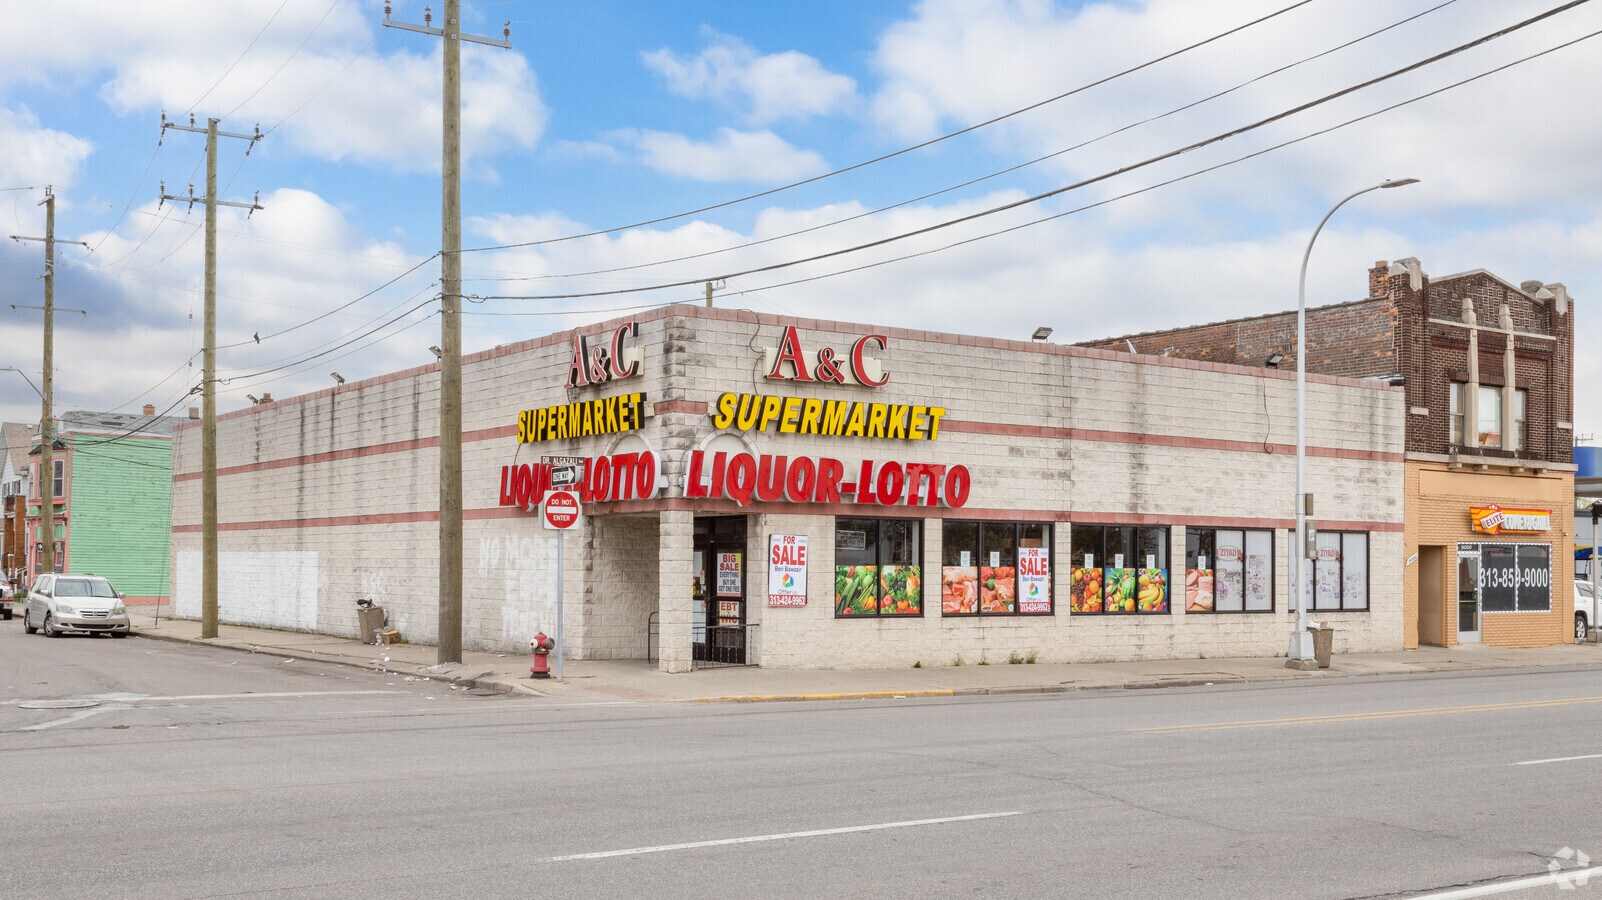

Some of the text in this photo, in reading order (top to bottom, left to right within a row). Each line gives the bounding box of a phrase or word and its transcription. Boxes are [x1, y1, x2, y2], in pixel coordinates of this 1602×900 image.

[564, 322, 640, 389] A&C
[767, 326, 890, 387] A&C
[516, 392, 647, 444] SUPERMARKET
[712, 392, 946, 441] SUPERMARKET
[553, 457, 578, 465] ALGAZALI
[553, 472, 561, 480] ONE
[683, 450, 970, 509] LIQUOR-LOTTO
[1485, 512, 1505, 527] ELITE
[783, 535, 796, 544] FOR
[722, 554, 736, 562] BIG
[771, 544, 806, 566] SALE
[1028, 549, 1039, 557] FOR
[1220, 548, 1237, 557] ZIYAD
[1320, 549, 1335, 557] ZIYAD
[719, 563, 739, 571] SALE
[1020, 557, 1047, 576] SALE
[1480, 567, 1548, 588] 313-859-9000
[721, 602, 737, 611] EBT
